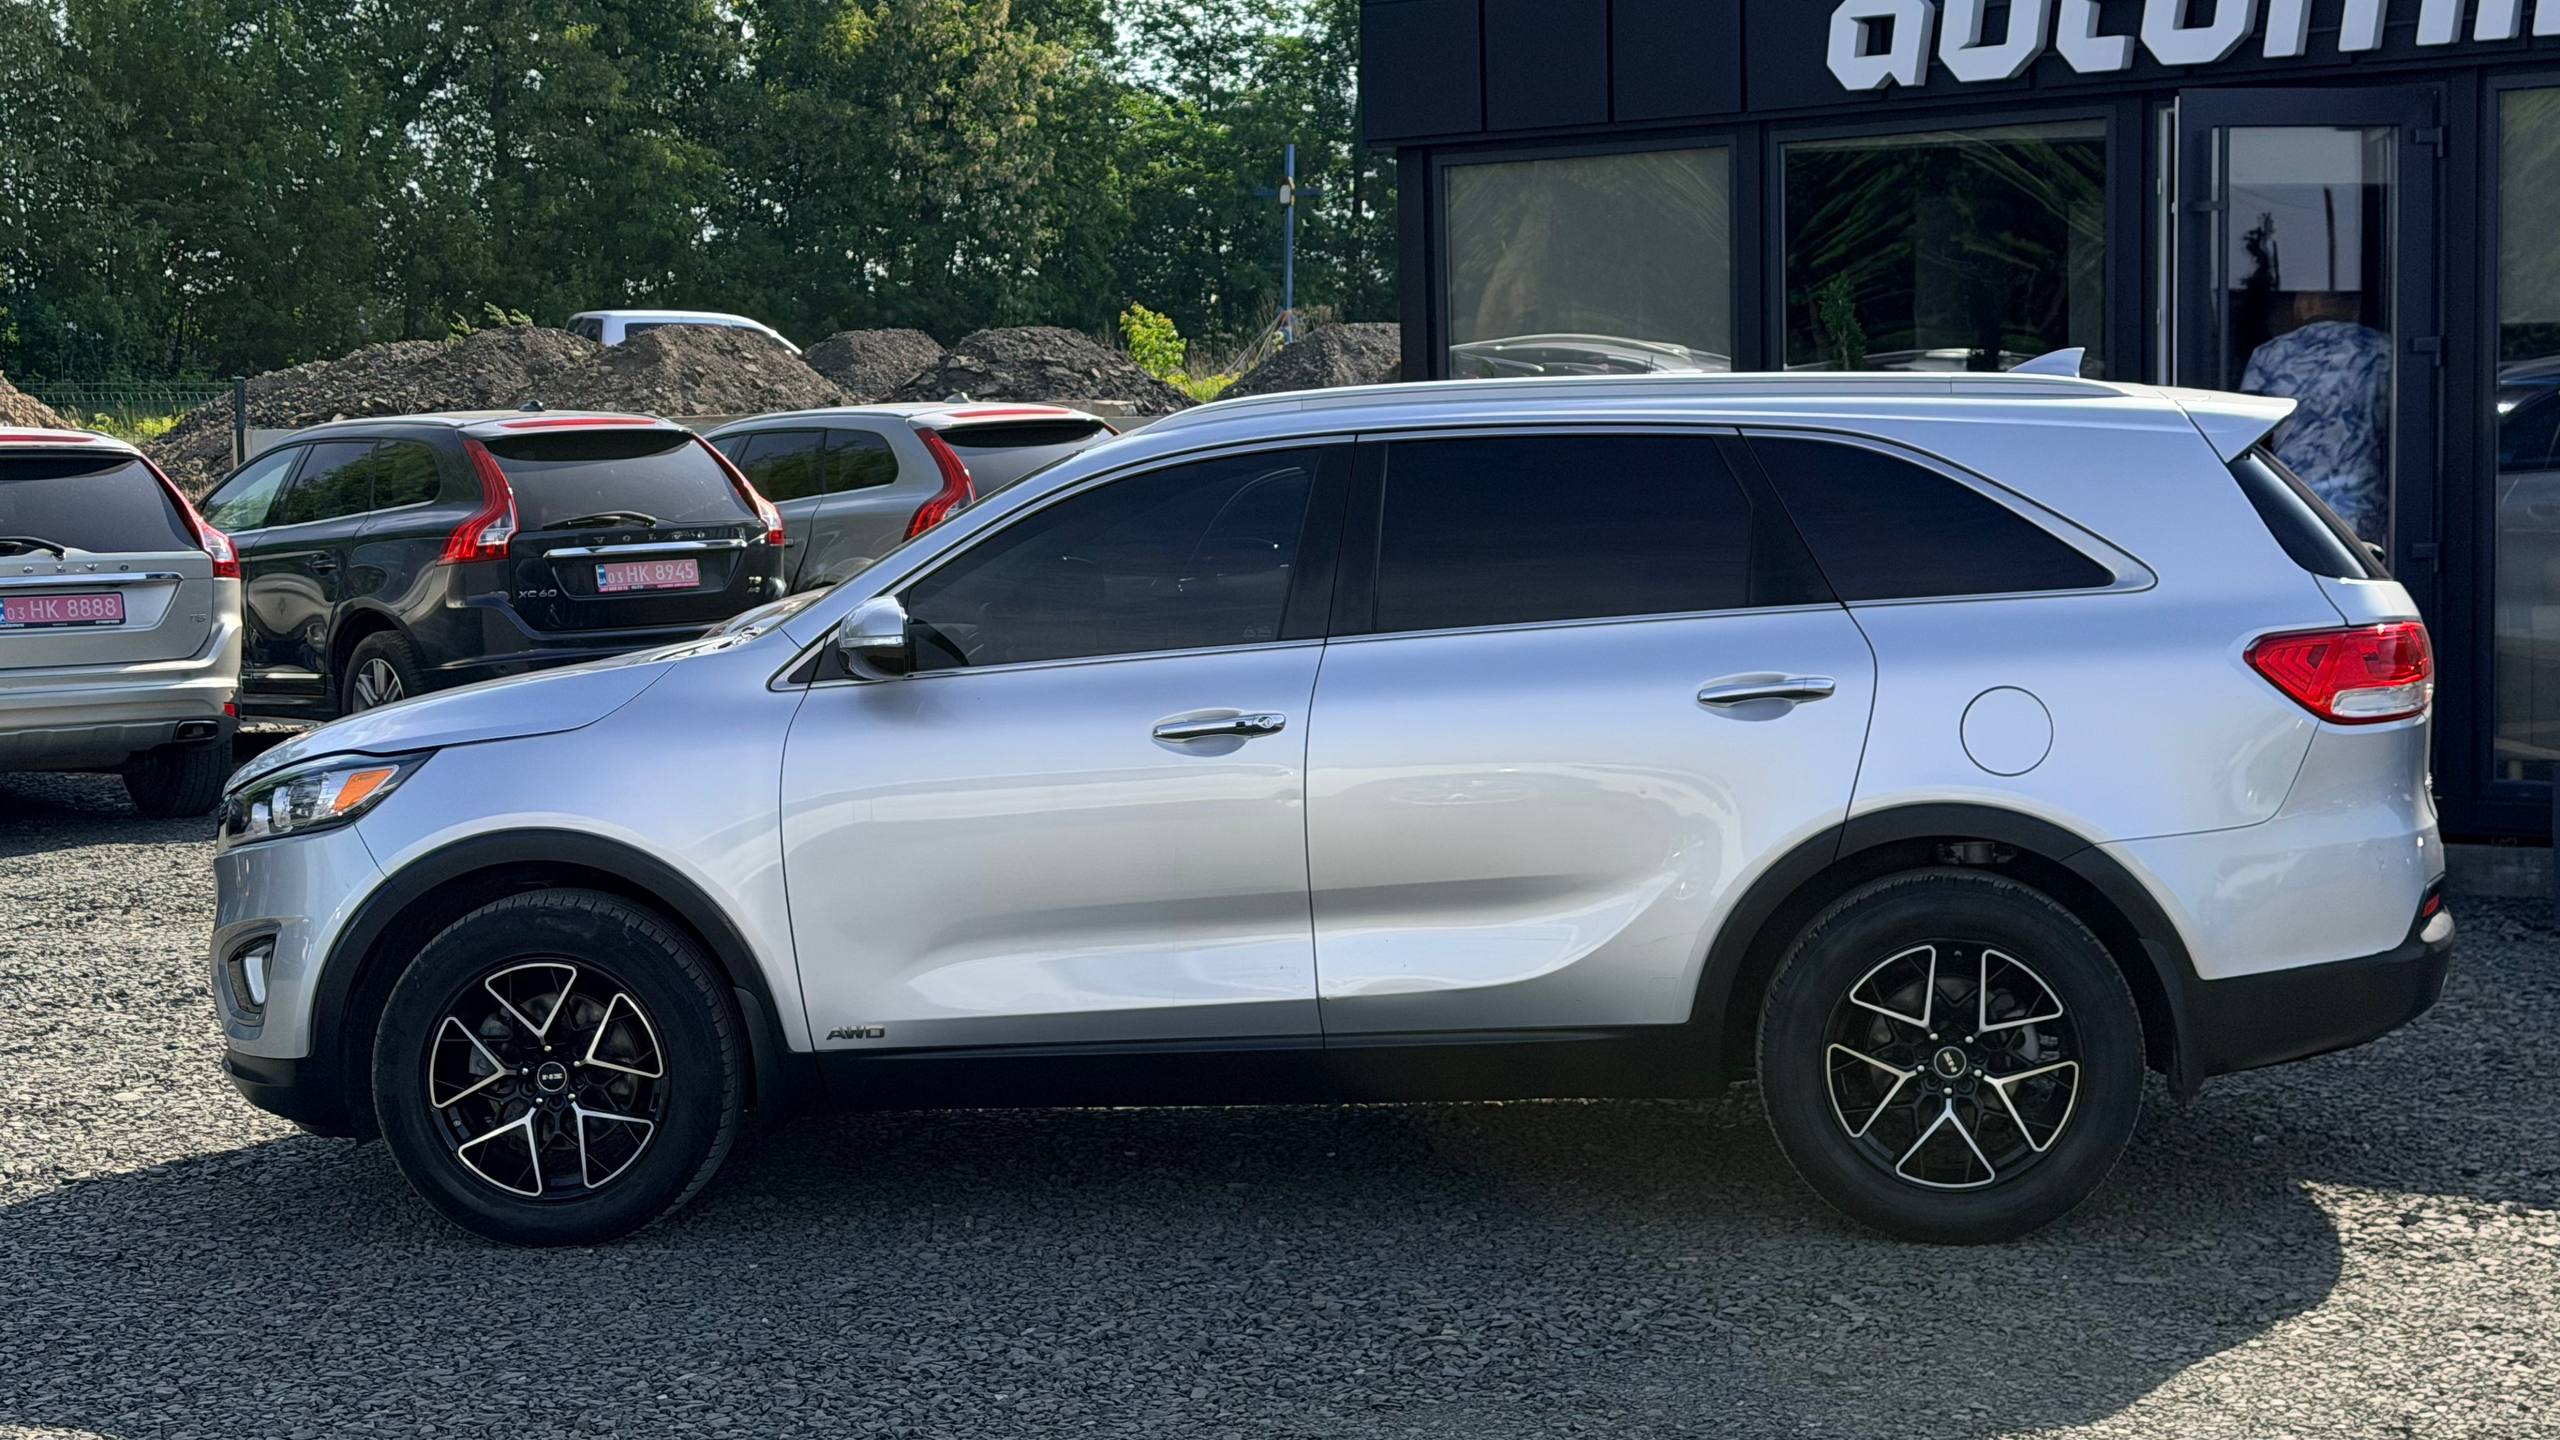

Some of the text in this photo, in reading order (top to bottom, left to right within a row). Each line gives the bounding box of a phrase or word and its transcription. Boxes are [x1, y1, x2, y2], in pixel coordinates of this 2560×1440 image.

[608, 562, 694, 584] 03 HK 8945
[7, 598, 116, 621] 03 HK 8888
[825, 1026, 885, 1041] AWD
